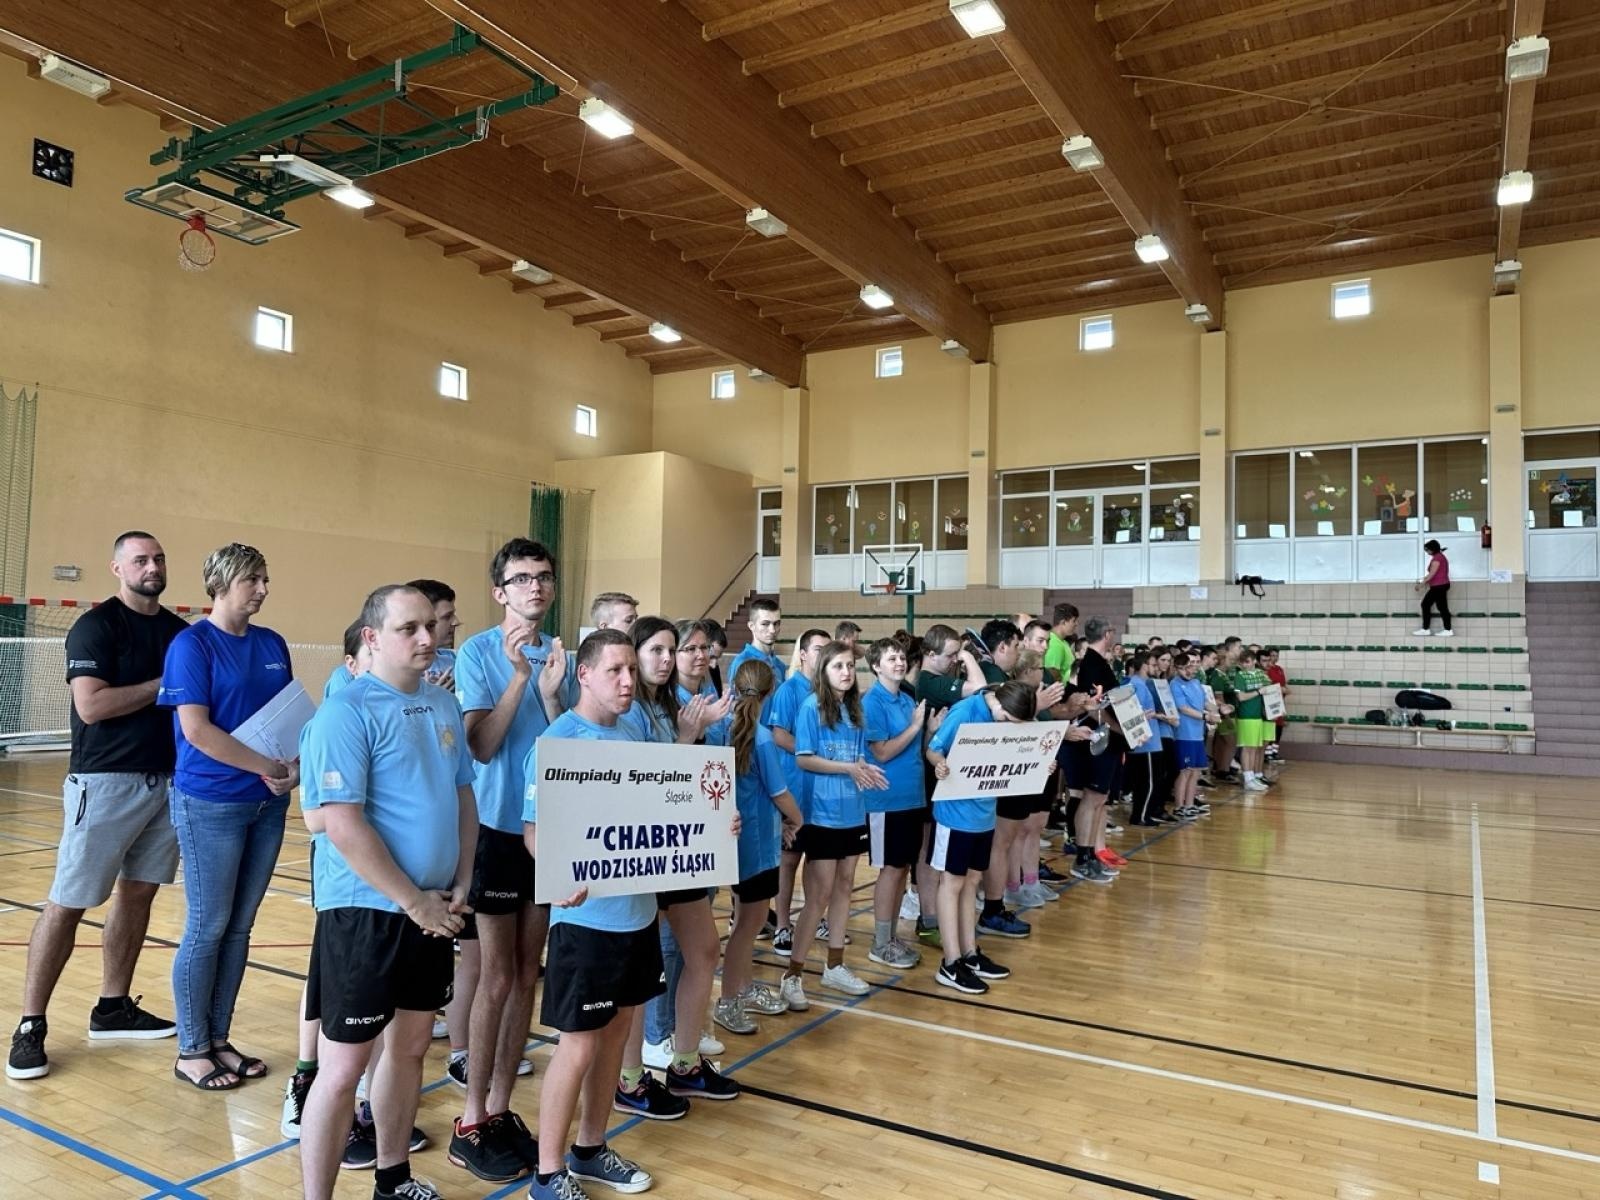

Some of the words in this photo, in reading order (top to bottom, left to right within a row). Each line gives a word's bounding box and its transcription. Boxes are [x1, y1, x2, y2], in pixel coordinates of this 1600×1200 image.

[544, 768, 622, 784] Olimpiady
[628, 769, 692, 785] Specjalne
[977, 779, 1010, 790] RYBNIK
[665, 788, 693, 805] Śląskie
[572, 856, 667, 882] WODZISŁAW
[672, 850, 715, 877] ŚLĄSKI
